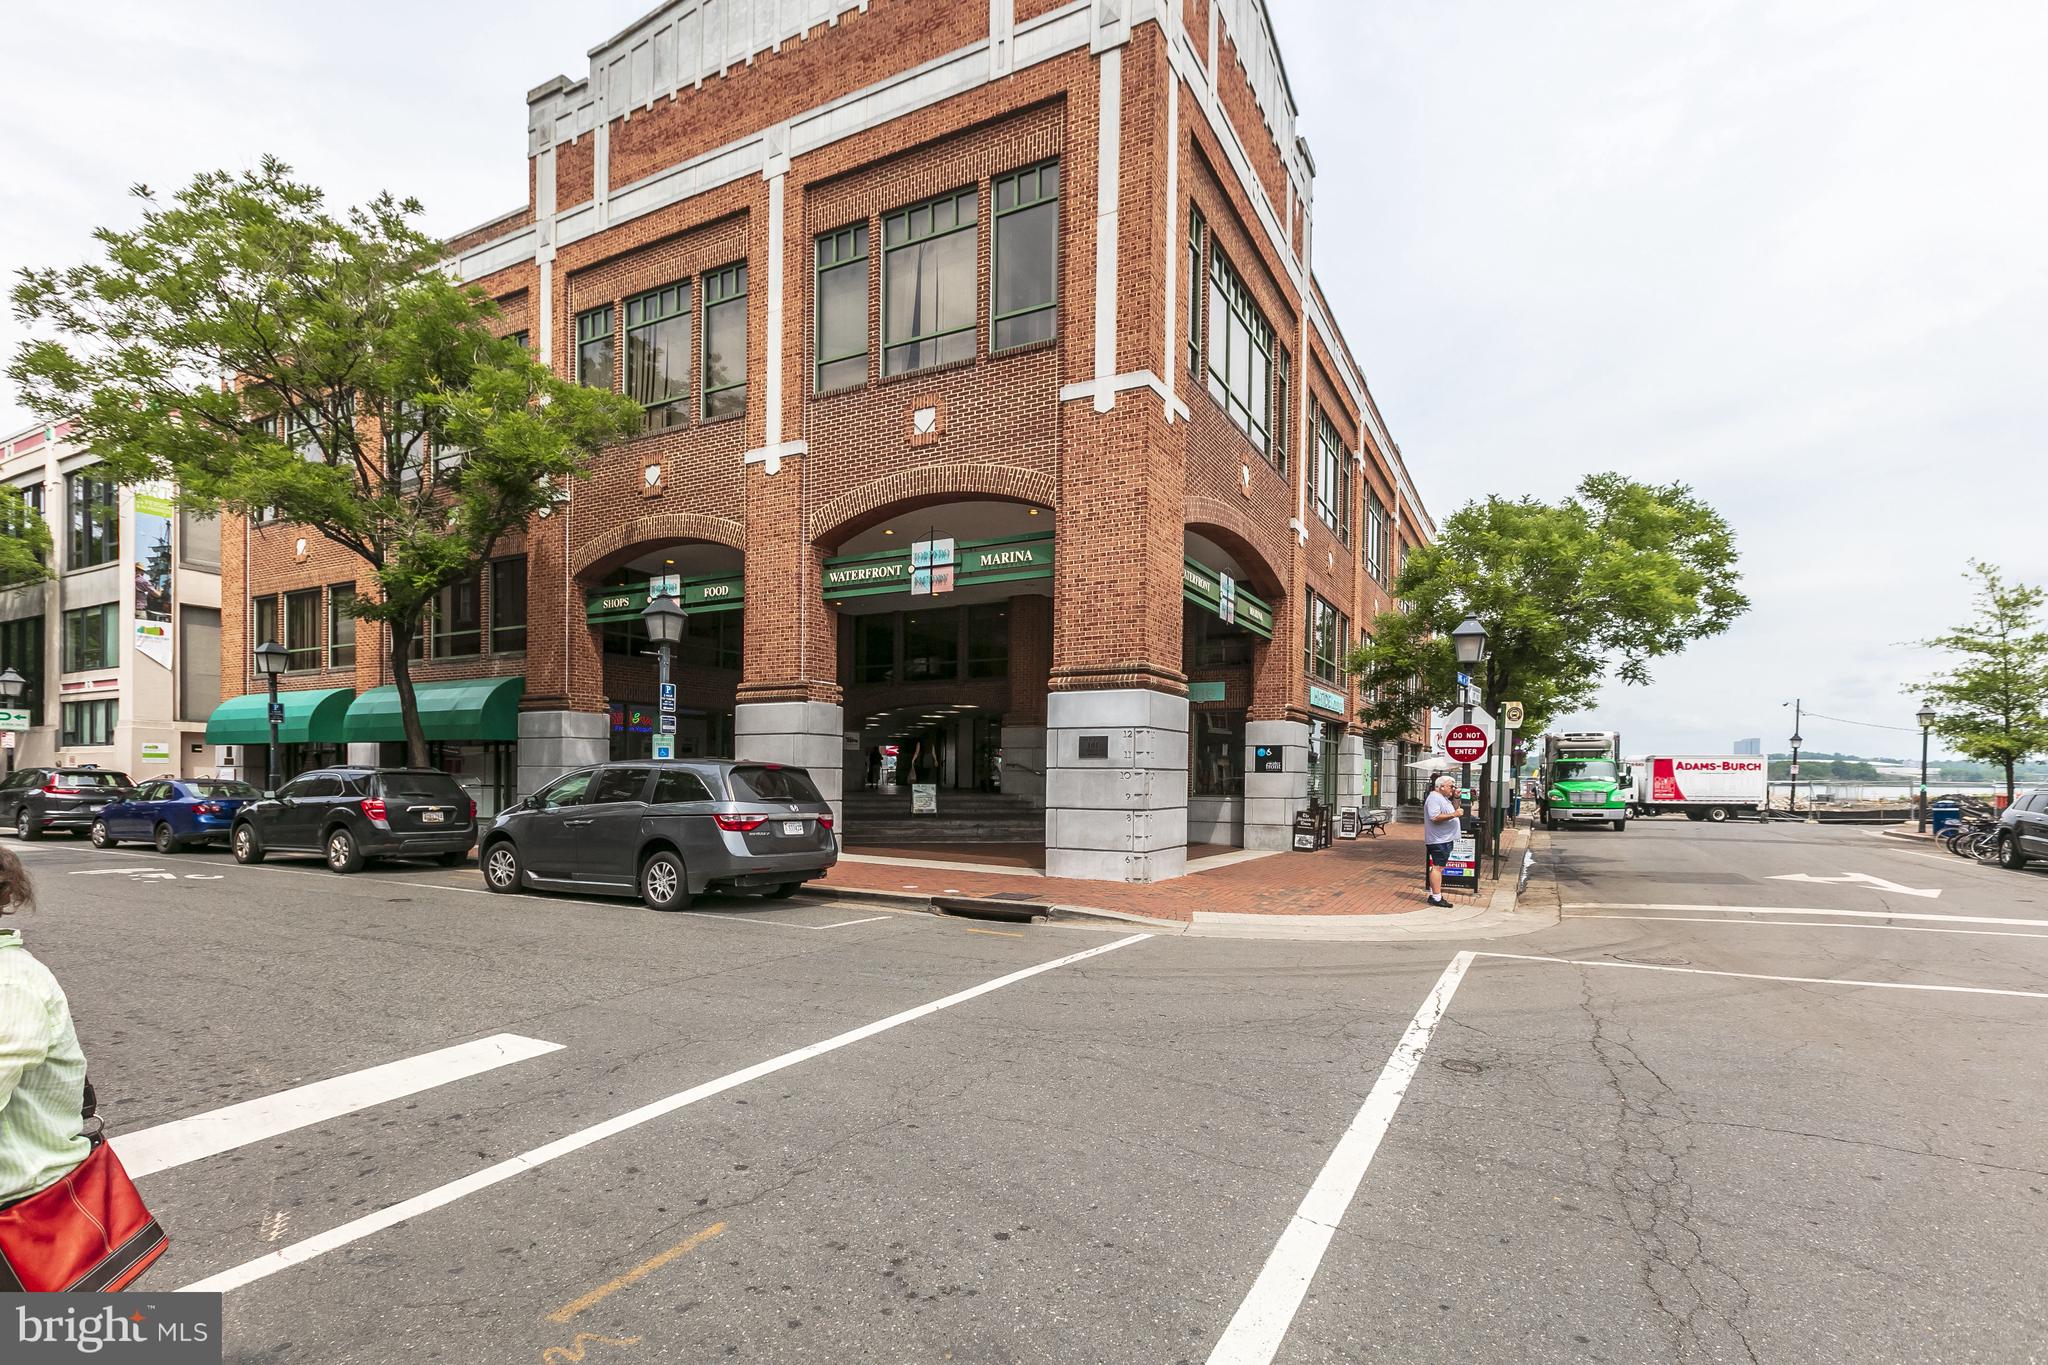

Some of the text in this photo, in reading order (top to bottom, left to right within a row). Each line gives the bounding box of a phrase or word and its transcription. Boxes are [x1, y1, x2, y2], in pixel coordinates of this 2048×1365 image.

[980, 549, 1033, 566] MARINA
[829, 565, 903, 583] WATERFRONT
[704, 585, 729, 598] FOOD
[603, 597, 630, 609] SHOPS
[665, 685, 672, 694] P
[1123, 730, 1133, 738] 12
[1123, 750, 1132, 759] 11
[1675, 761, 1762, 771] ADAMS-BURCH
[1120, 771, 1132, 780] 10
[1125, 793, 1131, 801] 9
[1125, 834, 1132, 842] 7
[1125, 856, 1131, 864] 6
